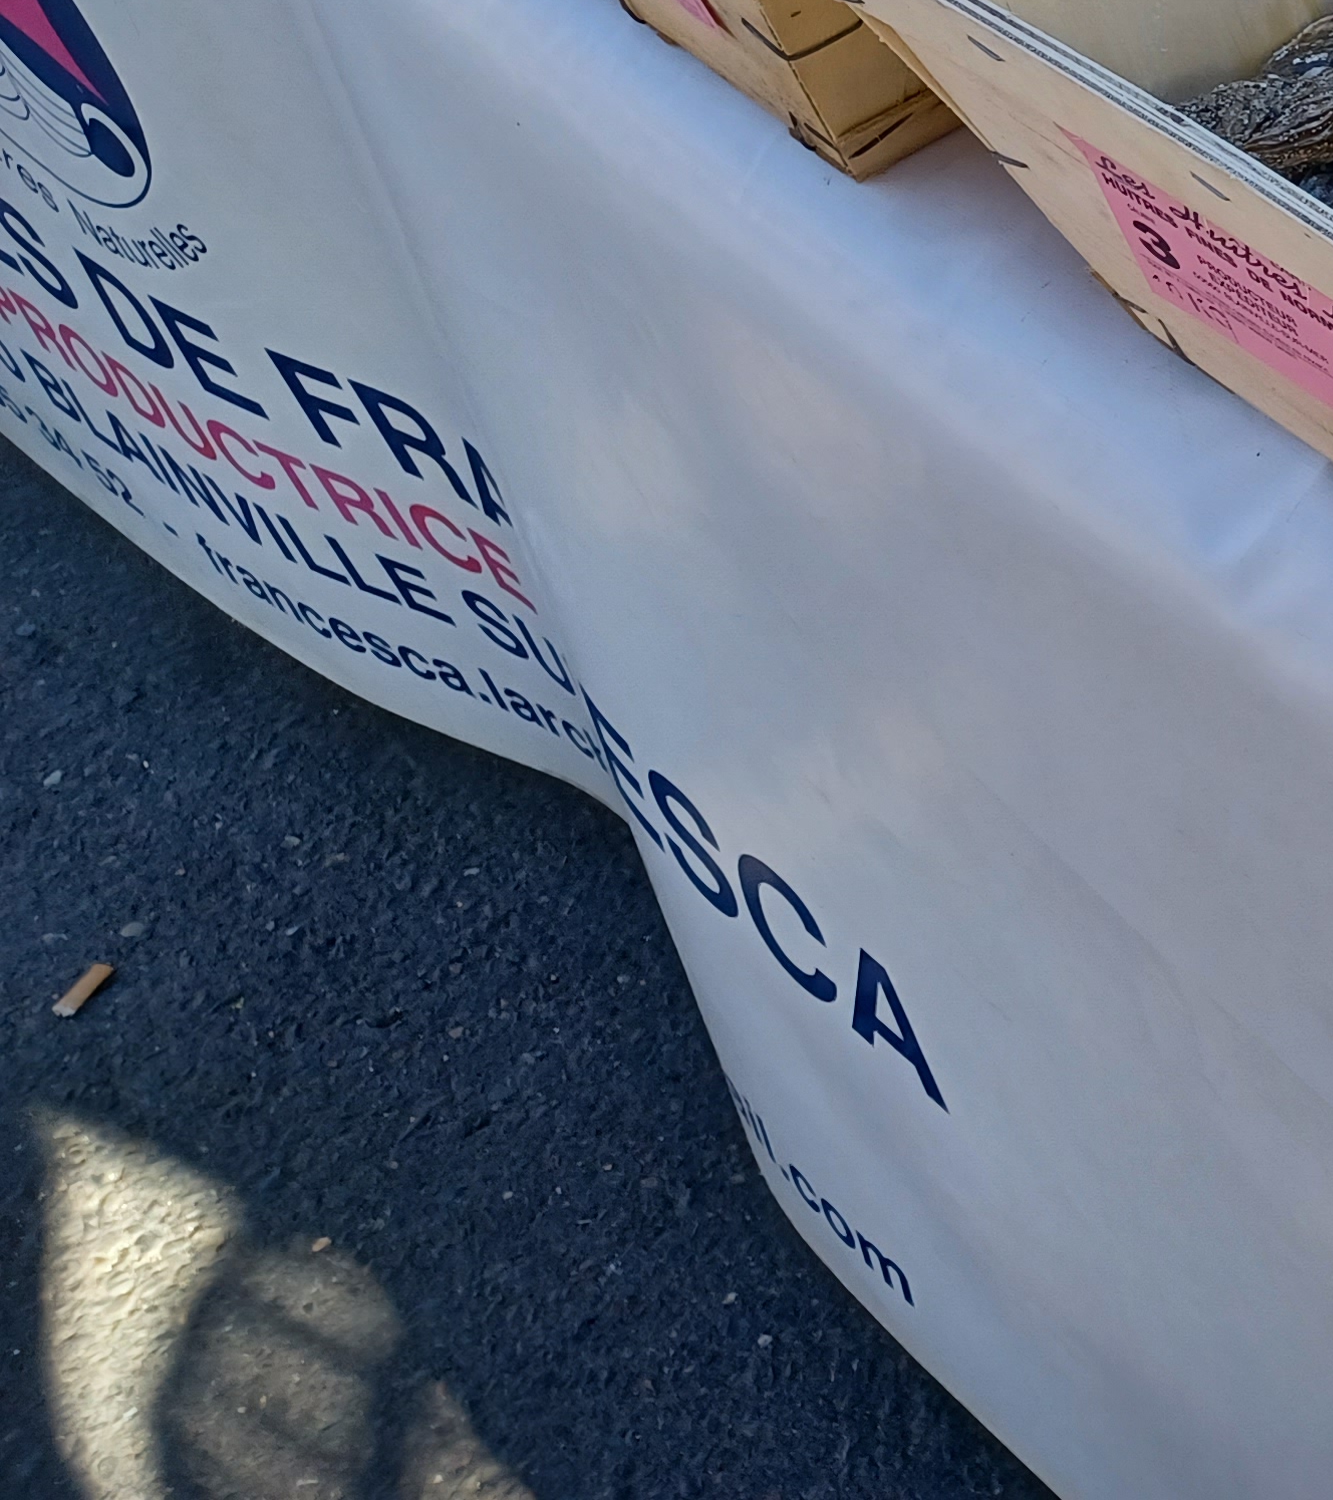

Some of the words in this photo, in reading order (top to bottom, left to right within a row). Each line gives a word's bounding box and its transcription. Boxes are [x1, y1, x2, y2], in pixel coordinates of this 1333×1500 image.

[0, 148, 59, 213] res
[66, 197, 207, 271] Naturelles
[1101, 172, 1179, 229] HUITRES
[1184, 226, 1238, 269] FINES
[1245, 267, 1274, 293] DE
[1132, 219, 1181, 270] 3
[72, 245, 270, 421] DE
[20, 347, 457, 628] BLAINVILLE
[81, 447, 146, 518] 52
